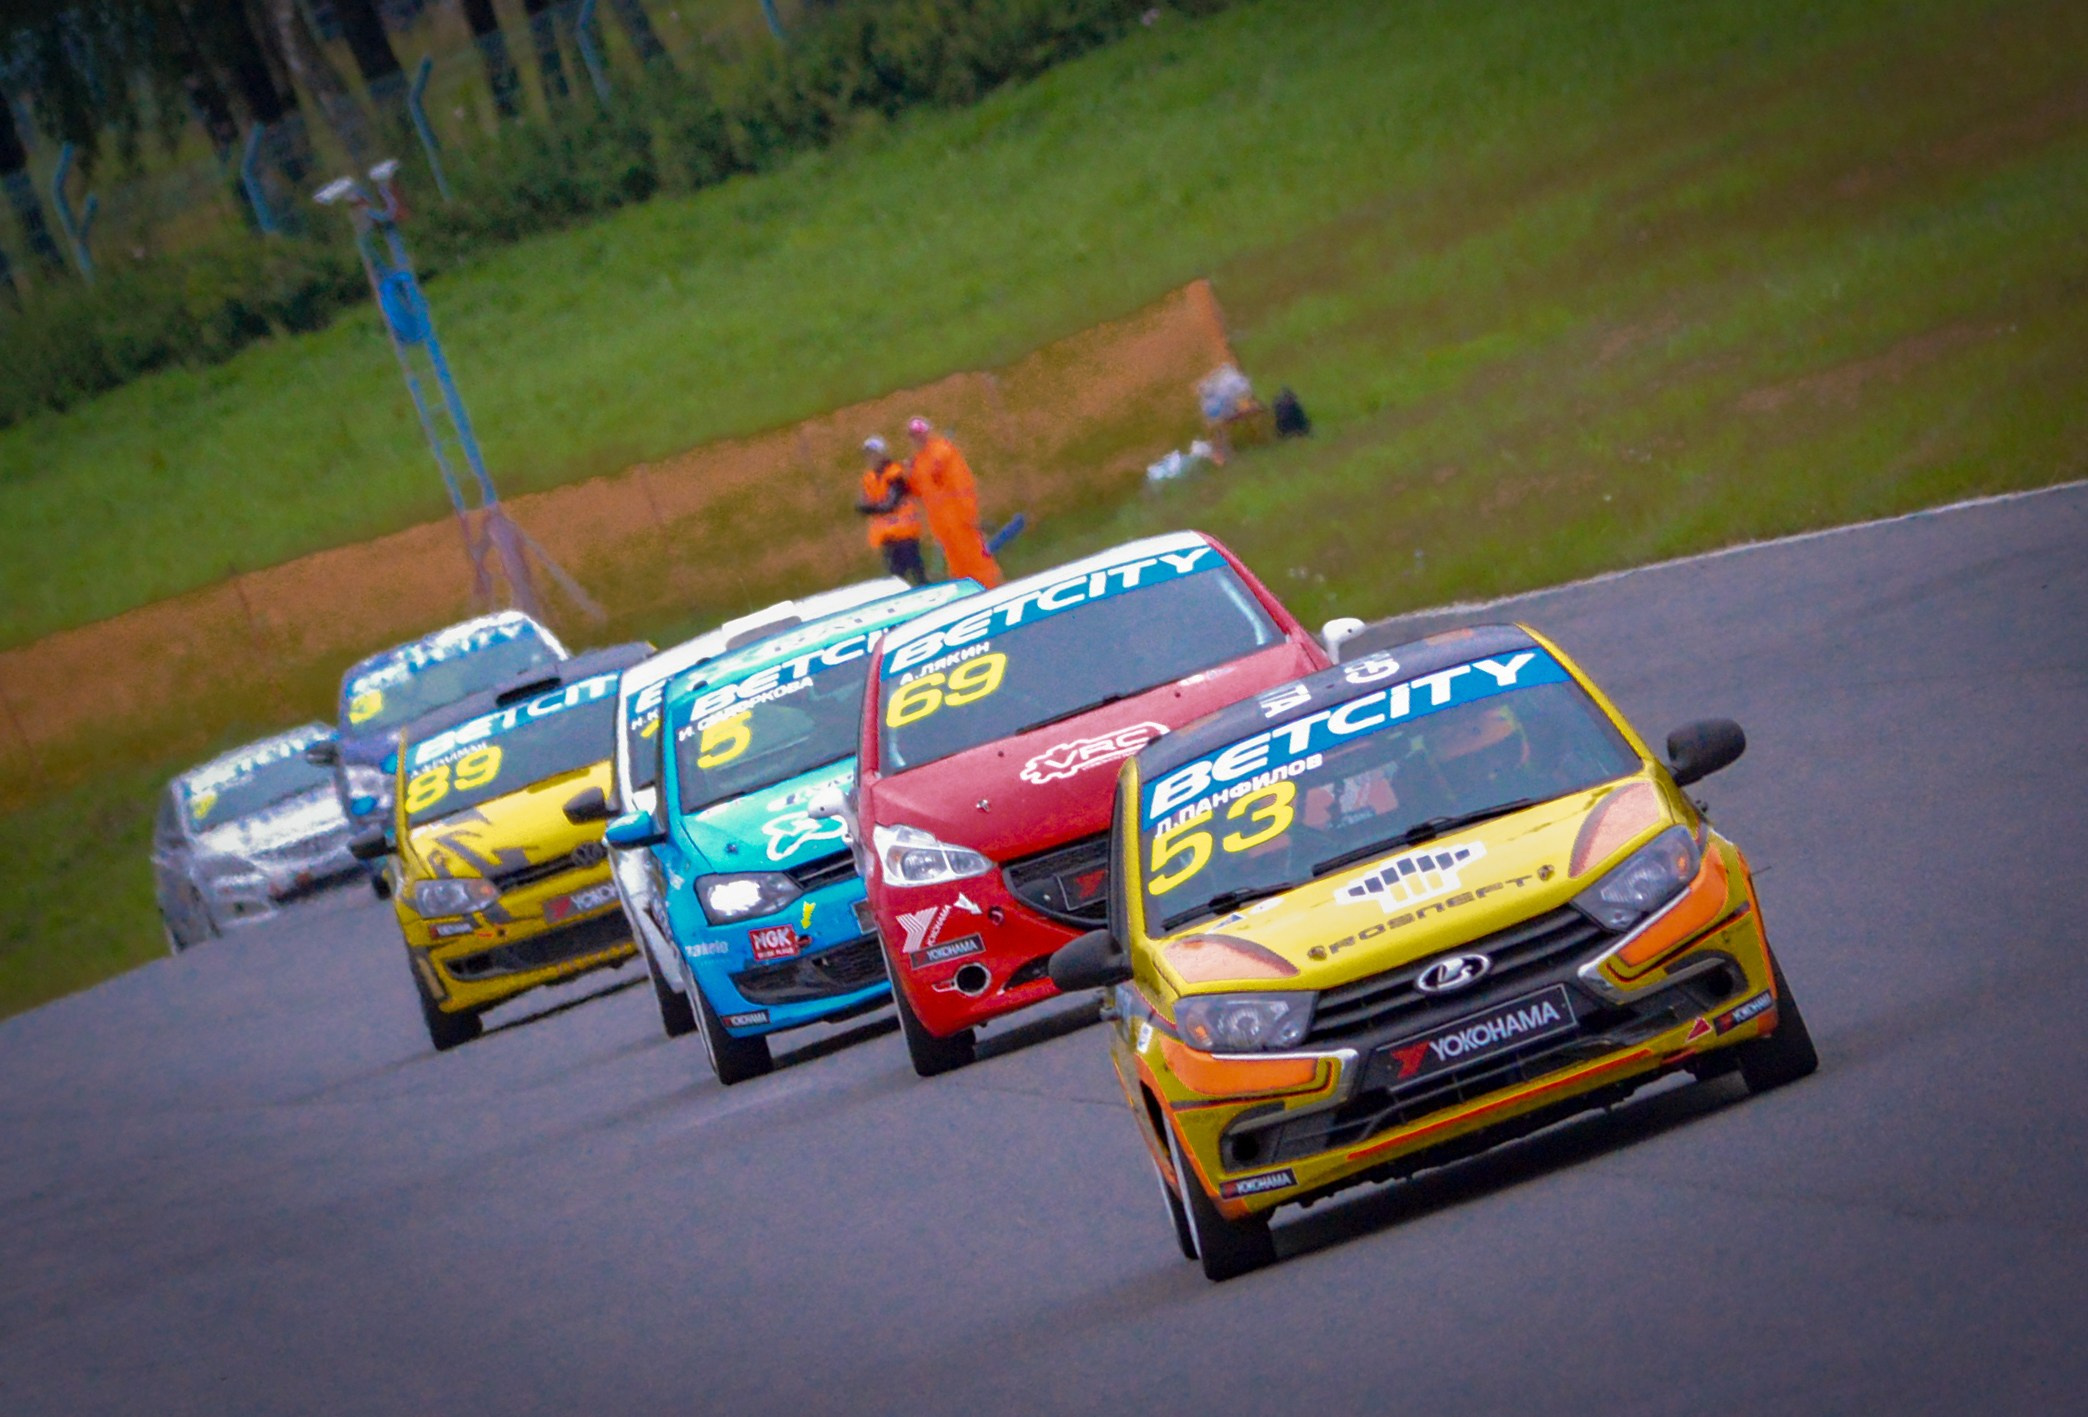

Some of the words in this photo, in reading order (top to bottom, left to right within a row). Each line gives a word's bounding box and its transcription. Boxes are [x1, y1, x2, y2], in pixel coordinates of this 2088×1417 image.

[889, 546, 1212, 673] BETCITY
[690, 628, 888, 721] BETCI
[886, 653, 1007, 728] 69
[415, 674, 618, 764] BETCIT
[697, 710, 752, 769] 5
[1045, 729, 1150, 768] VRC
[1150, 653, 1536, 819] BETCITY
[405, 745, 503, 813] 89
[1155, 753, 1323, 838] Л.ПАНФИЛОВ
[1148, 781, 1296, 895] 53
[571, 883, 618, 910] YOKO
[752, 927, 792, 951] NGK
[926, 939, 979, 960] YOKOHAMA
[1428, 1001, 1561, 1061] YOKOHAMA
[1236, 1172, 1292, 1194] YOKOHAMA
